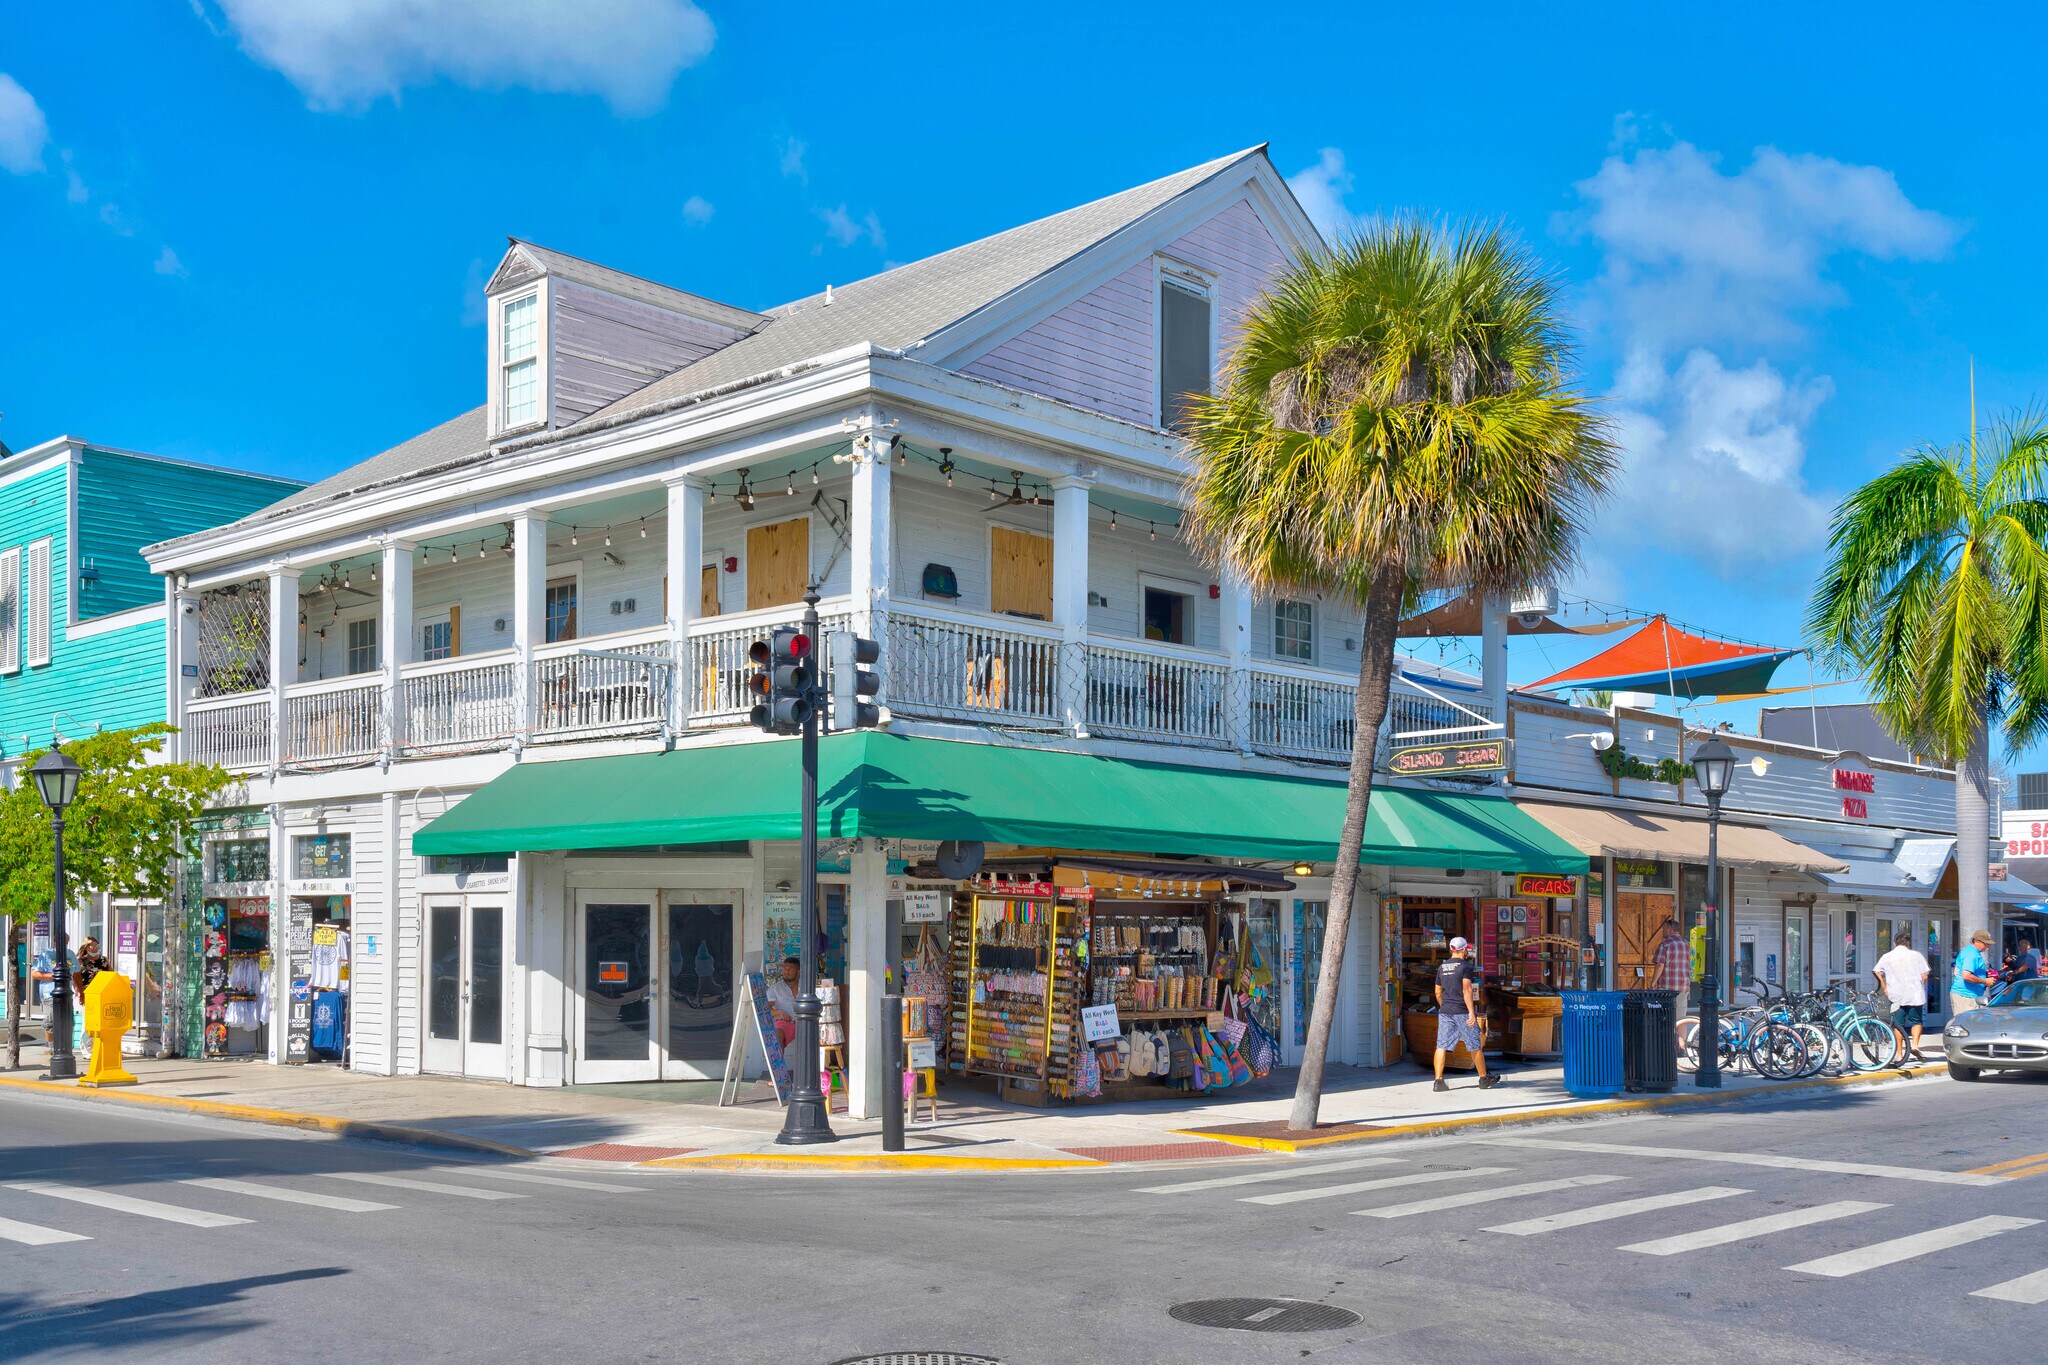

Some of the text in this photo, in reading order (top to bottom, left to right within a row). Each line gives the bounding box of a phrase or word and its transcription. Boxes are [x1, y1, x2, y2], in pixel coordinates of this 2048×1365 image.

[1397, 748, 1498, 769] ISLAND CIGAR
[1832, 768, 1875, 793] PARADISE
[1841, 797, 1868, 819] PIZZA
[314, 844, 327, 857] GET
[1521, 879, 1573, 895] CIGARS
[914, 894, 924, 902] Key
[290, 931, 312, 940] PEOPLE
[1092, 1011, 1103, 1019] Key
